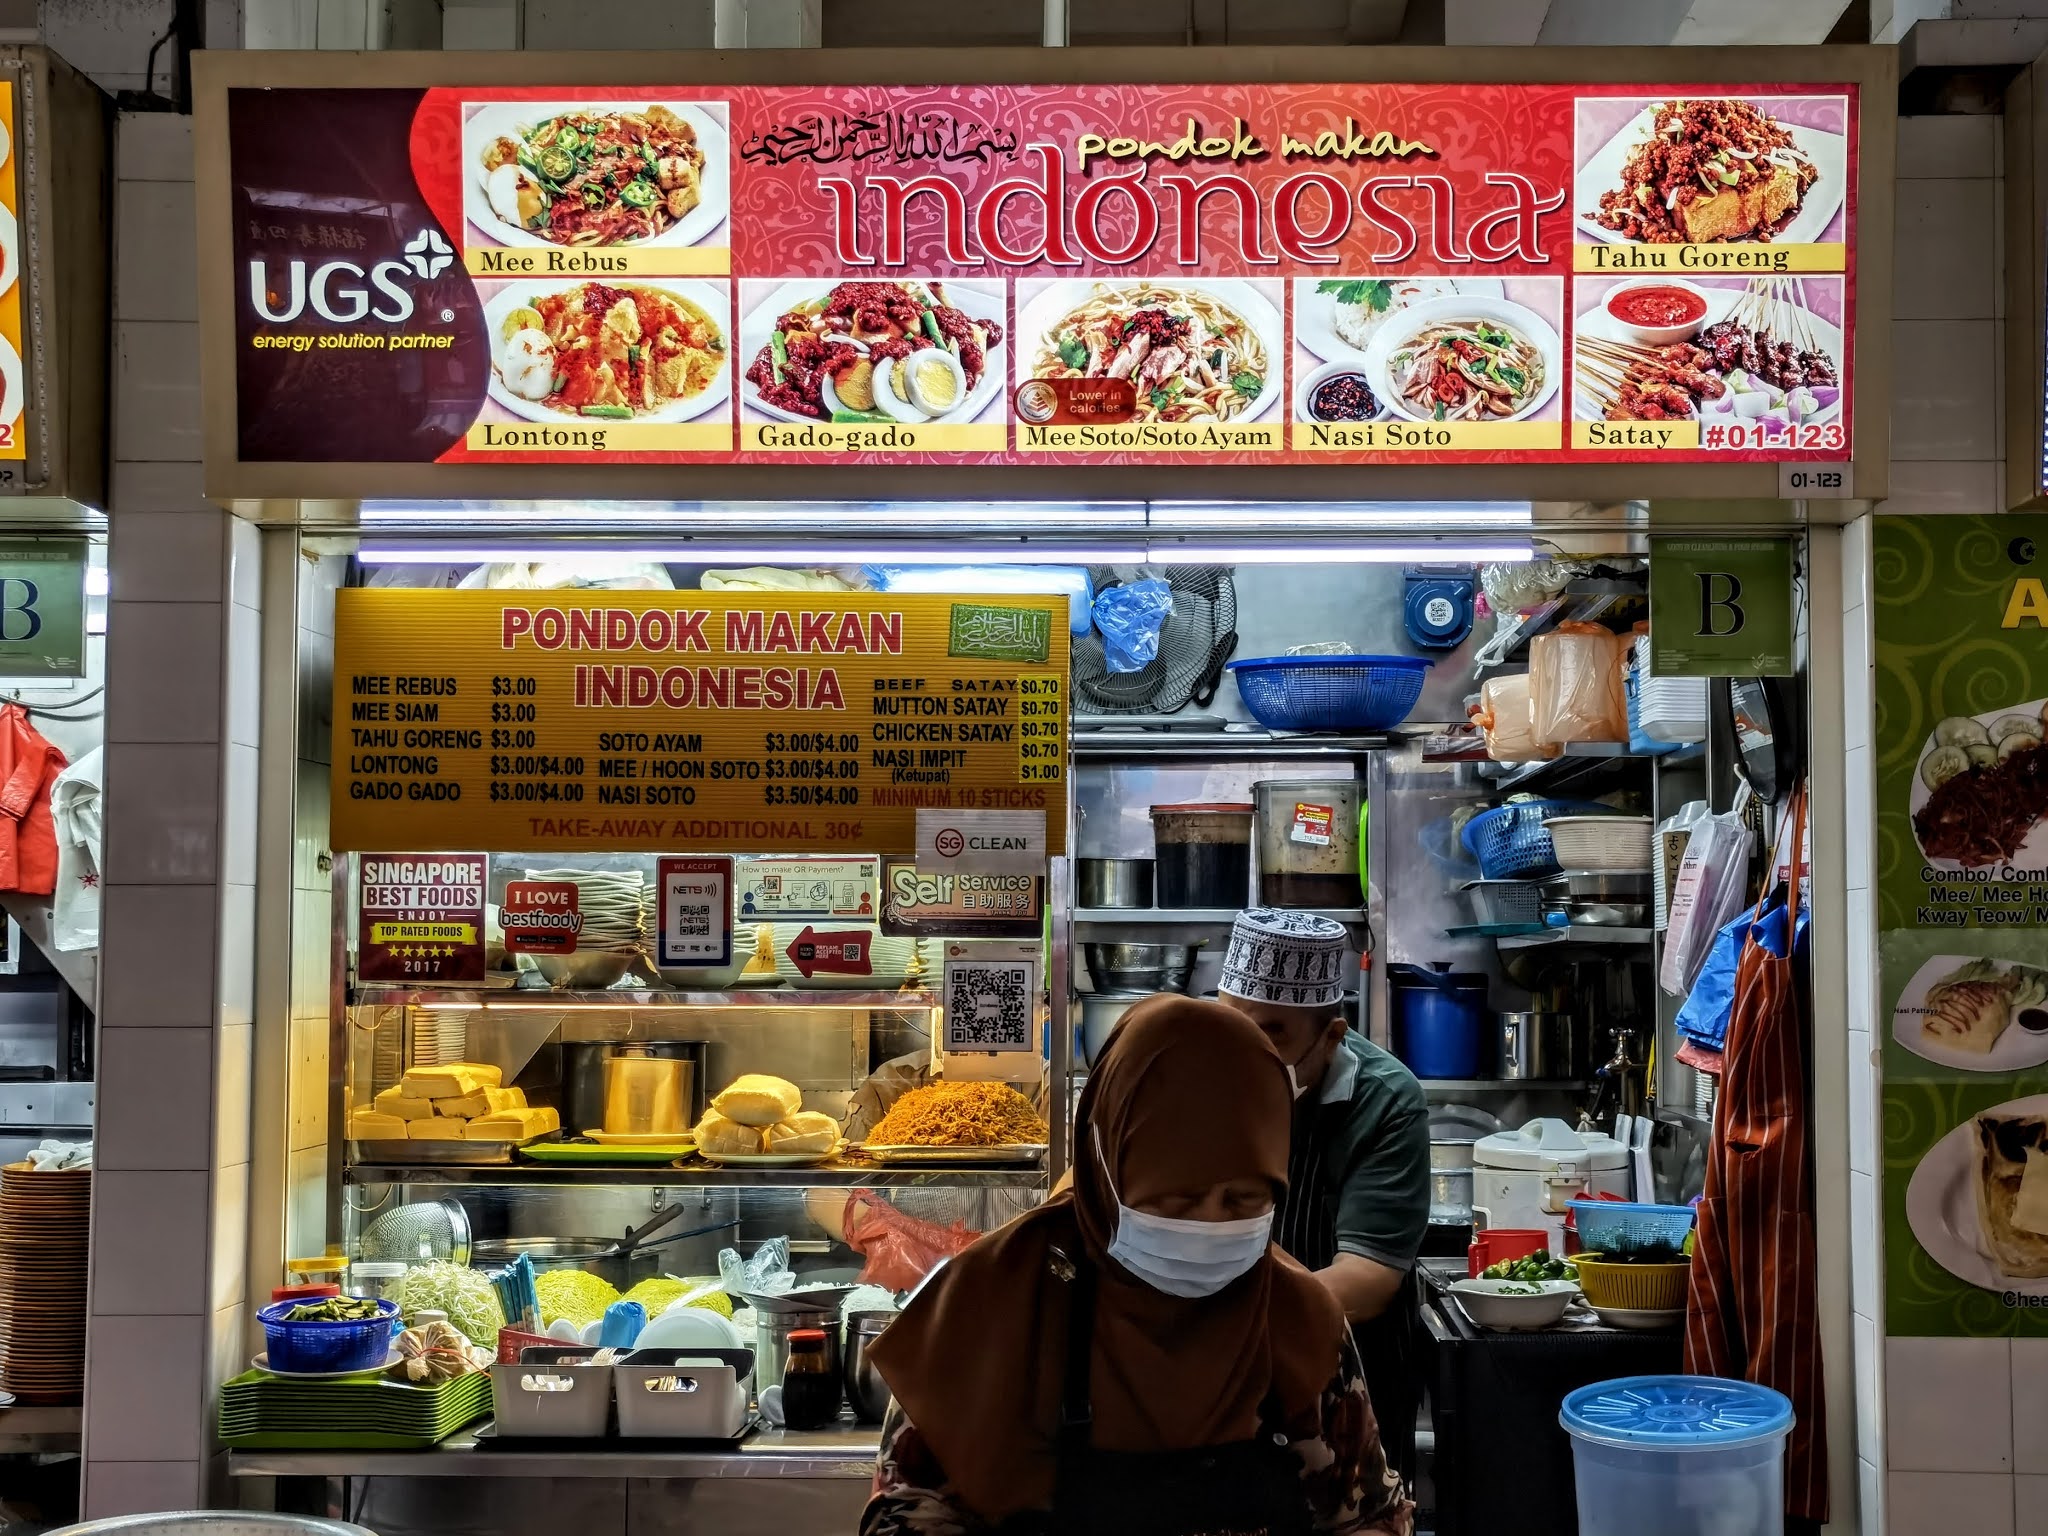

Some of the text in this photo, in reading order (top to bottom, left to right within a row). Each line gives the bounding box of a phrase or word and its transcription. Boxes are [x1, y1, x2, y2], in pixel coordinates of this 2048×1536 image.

[1078, 116, 1433, 170] pondok makan
[818, 142, 1565, 266] indonesia
[480, 251, 628, 272] Mee Rebus
[1591, 246, 1789, 272] Tahu Goreng
[250, 261, 414, 323] UGS
[253, 333, 455, 351] energy solution partner
[1070, 390, 1121, 400] Lower in
[1070, 402, 1121, 413] calories
[485, 425, 607, 451] Lontong
[757, 425, 916, 451] Gado-gado
[1026, 425, 1272, 451] Mee Soto/Soto Ayam
[1310, 424, 1452, 446] Nasi Soto
[1588, 424, 1672, 450] Satay
[1706, 424, 1844, 449] #01-123
[1791, 473, 1842, 488] 01-123
[0, 577, 42, 641] B
[1694, 572, 1745, 636] B
[502, 607, 902, 654] PONDOK MAKAN
[352, 676, 536, 697] MEE REBUS $3.00
[574, 665, 846, 710] INDONESIA
[874, 678, 1058, 695] BEEF SATAY $0.70
[352, 702, 536, 724] MEE SIAM $3.00
[873, 697, 1058, 716] MUTTON SATAY $0.70
[351, 729, 535, 750] TAHU GORENG $3.00
[872, 722, 1059, 742] CHICKEN SATAY $0.70
[599, 732, 859, 754] SOTO AYAM $3.00/$4.00
[872, 743, 1059, 768] NASI IMPIT $0.70
[351, 755, 584, 778] LONTONG $3.00/$4.00
[599, 759, 637, 778] MEE
[652, 760, 704, 779] HOON
[710, 761, 760, 780] SOTO
[765, 759, 859, 781] $3.00/$4.00
[892, 768, 950, 785] (Ketupat)
[1021, 764, 1060, 780] $1.00
[350, 781, 584, 803] GADO GADO $3.00/$4.00
[598, 785, 859, 807] NASI SOTO $3.50/$4.00
[872, 788, 1046, 808] MINIMUM 10 STICKS
[528, 818, 863, 840] TAKE-AWAY ADDITIONAL 30¢
[939, 837, 1027, 850] SG CLEAN
[364, 862, 482, 885] SINGAPORE
[794, 866, 806, 874] QR
[808, 866, 844, 875] Payment?
[1920, 866, 1995, 882] Combo/
[366, 886, 477, 907] BEST FOODS
[514, 891, 569, 905] I LOVE
[673, 885, 703, 894] NETS
[894, 870, 1031, 908] Self Service
[1929, 886, 1977, 902] Mee/
[1983, 886, 2023, 902] Mee
[962, 893, 1031, 909] 自助服务
[398, 910, 446, 920] ENJOY
[500, 908, 581, 933] bestfoody
[1917, 907, 1969, 927] Kway
[1973, 907, 2030, 923] Teow/
[381, 926, 463, 937] TOP RATED FOODS
[404, 961, 441, 973] 2017
